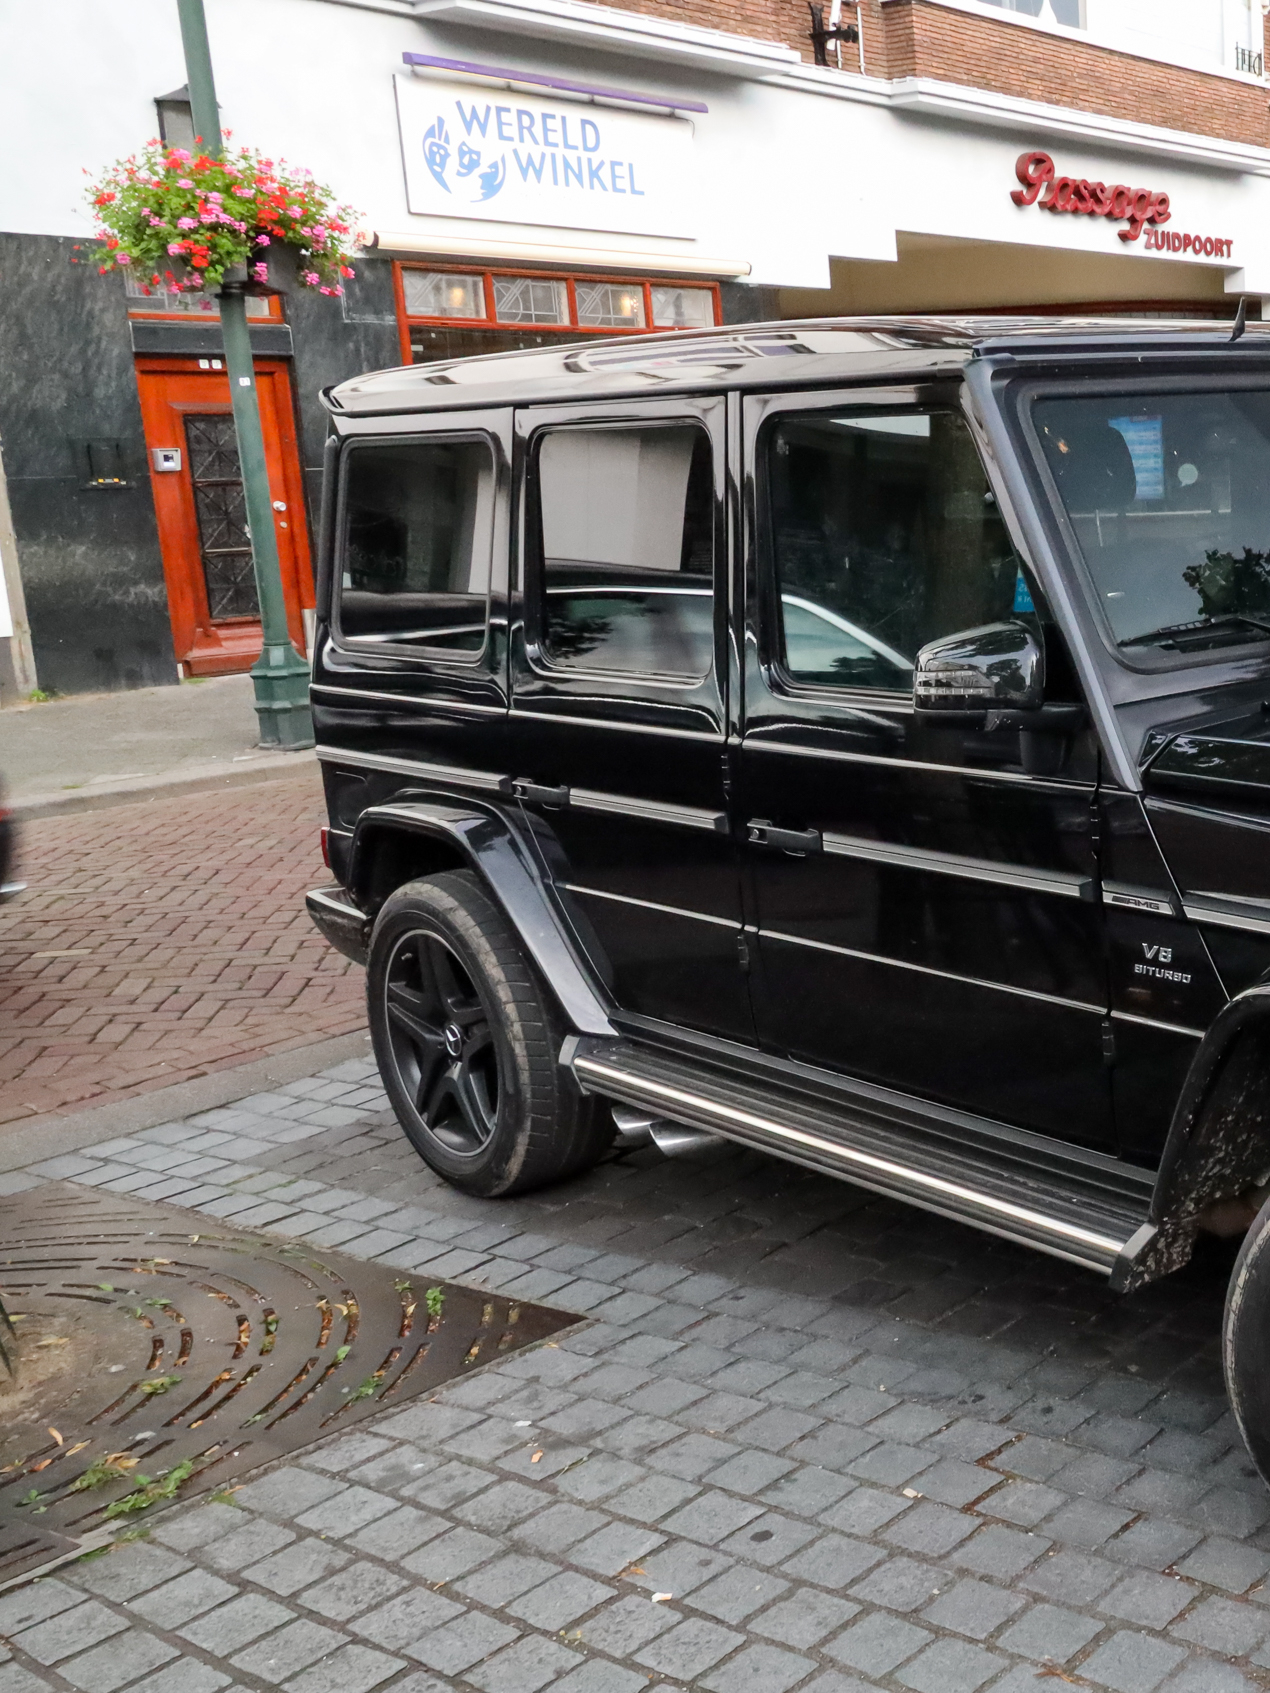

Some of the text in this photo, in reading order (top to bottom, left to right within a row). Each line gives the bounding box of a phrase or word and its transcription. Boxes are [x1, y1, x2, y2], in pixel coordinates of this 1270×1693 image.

[455, 100, 600, 153] WERELD
[512, 148, 645, 196] WINKEL
[1010, 151, 1171, 242] Passage
[1144, 228, 1233, 258] ZUIDPOORT
[1126, 899, 1160, 910] AMG
[1141, 943, 1172, 963] V8
[1134, 963, 1191, 983] BITURBO
